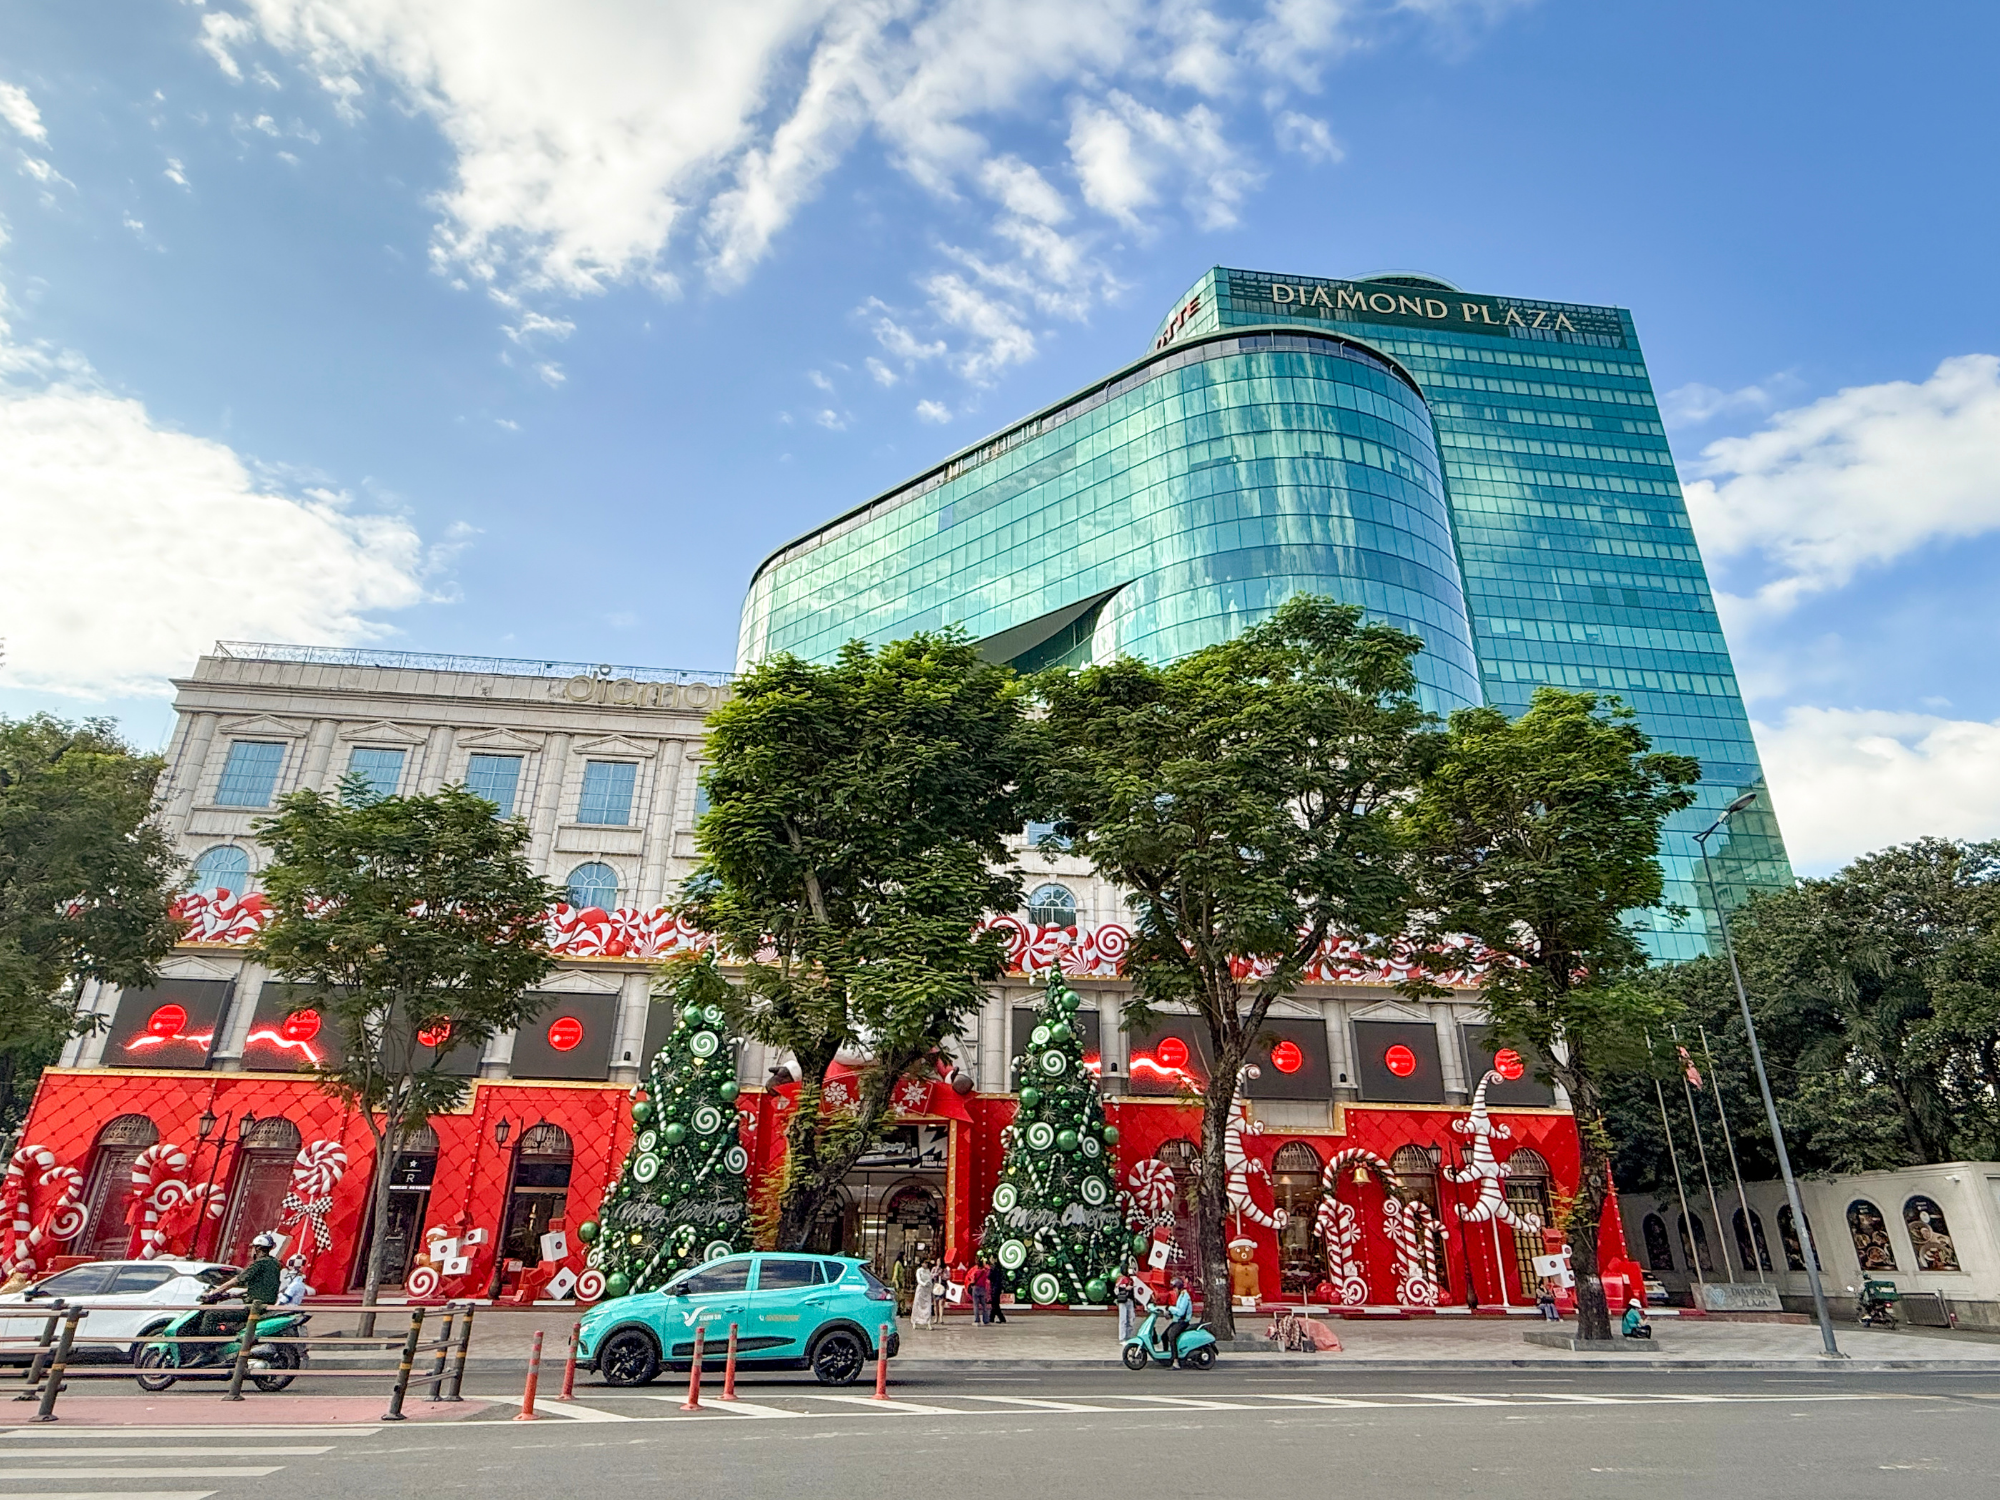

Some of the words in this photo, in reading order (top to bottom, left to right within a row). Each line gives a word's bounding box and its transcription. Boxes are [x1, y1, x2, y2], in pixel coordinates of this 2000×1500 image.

[1154, 294, 1200, 350] OTTE
[1272, 283, 1448, 319] DIAMOND
[1460, 302, 1577, 332] PLAZA
[564, 664, 735, 709] diamon
[614, 1200, 669, 1228] Merry
[670, 1197, 743, 1226] Christmas
[1004, 1206, 1062, 1232] Merry
[1061, 1202, 1121, 1230] Christmas
[1730, 1287, 1771, 1296] DIAMOND
[1741, 1299, 1769, 1308] PLAZA
